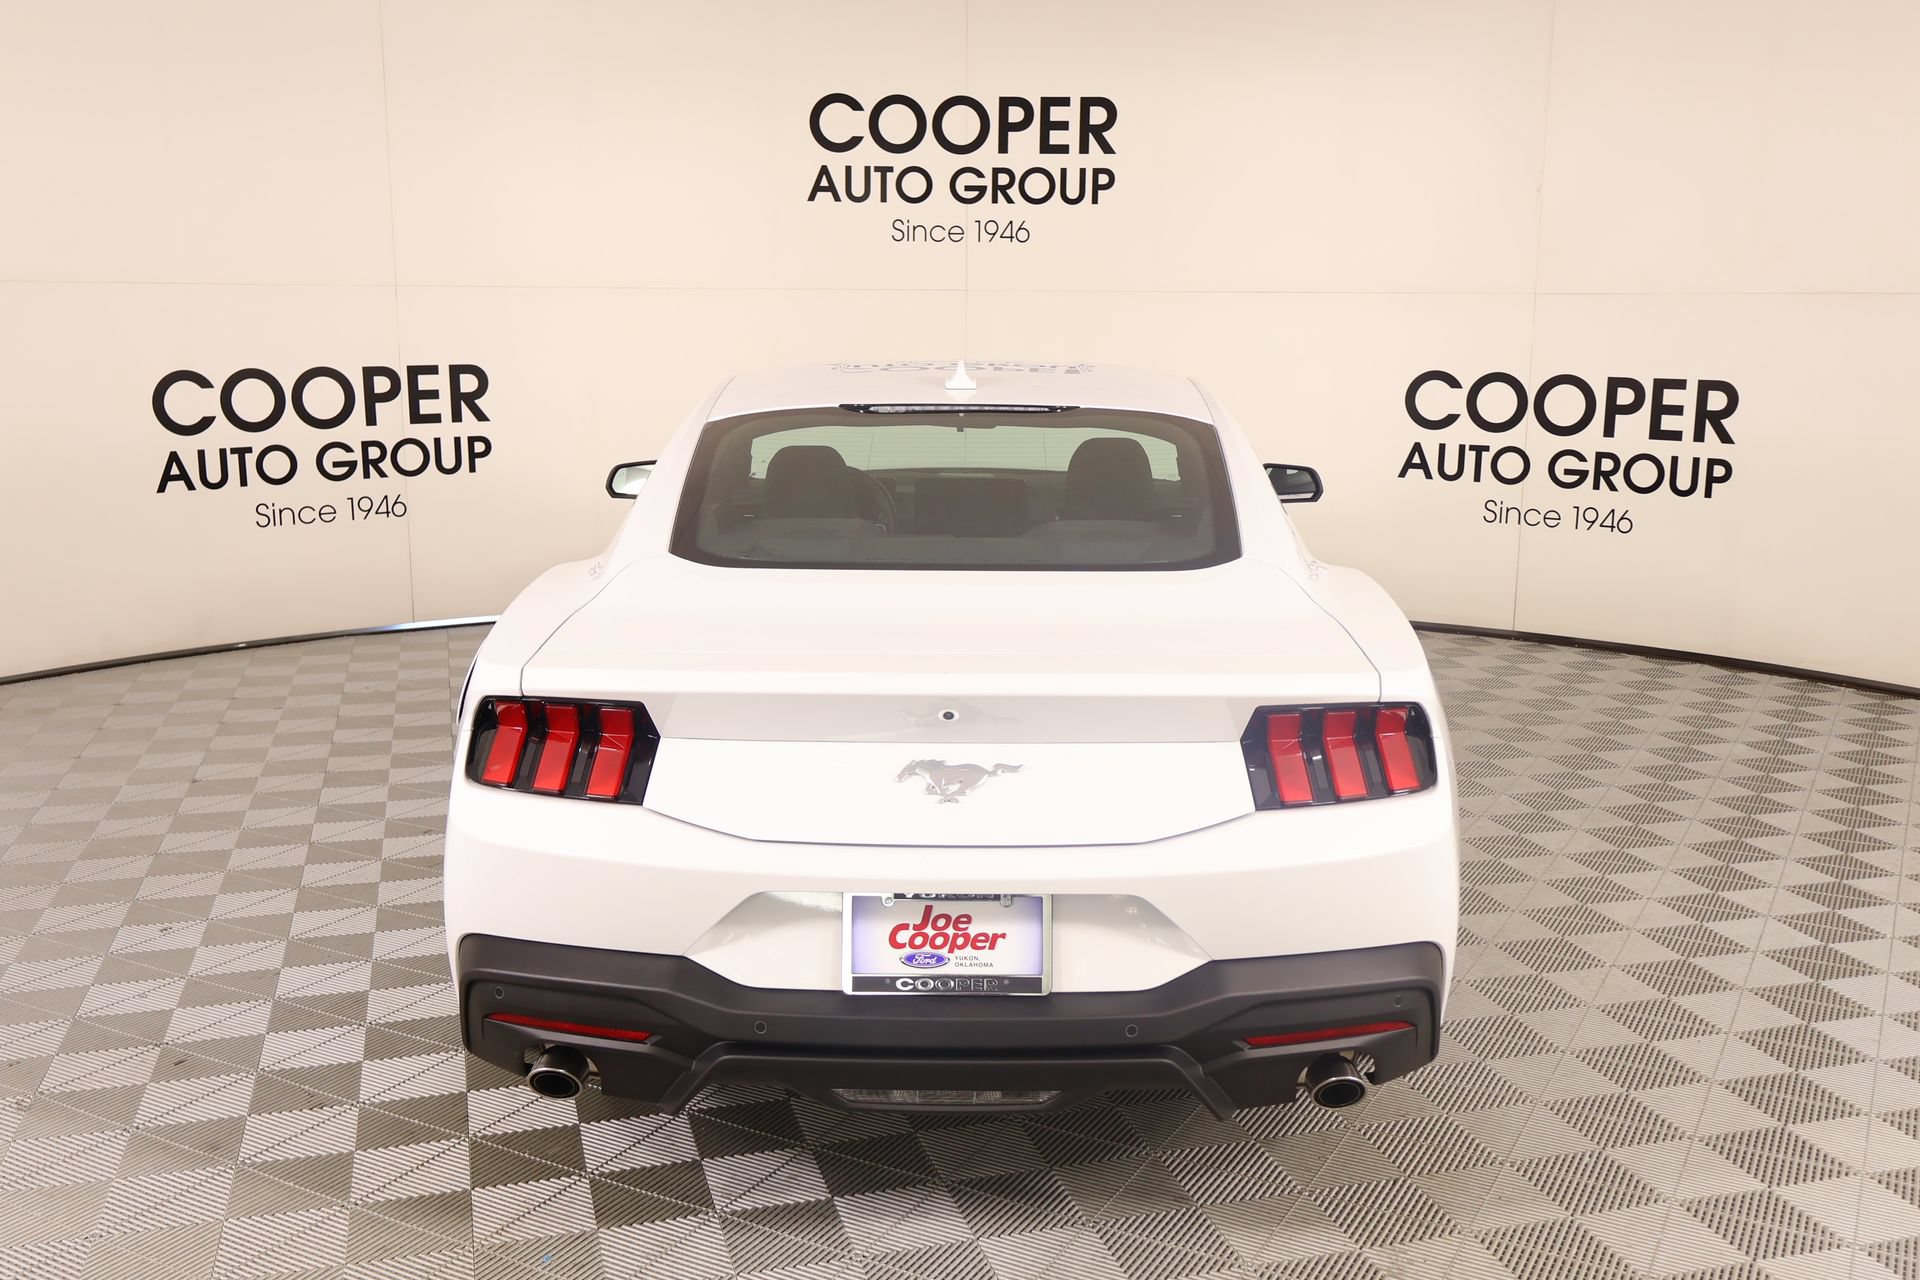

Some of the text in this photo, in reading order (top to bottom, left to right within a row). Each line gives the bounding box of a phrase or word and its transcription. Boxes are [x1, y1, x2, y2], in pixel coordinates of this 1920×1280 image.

[809, 92, 1118, 155] COOPER
[806, 164, 1116, 206] AUTO GROUP
[891, 218, 1031, 243] Since 1946
[151, 363, 491, 437] COOPER
[1404, 369, 1740, 445] COOPER
[155, 435, 493, 494] AUTO GROUP
[1397, 441, 1733, 499] AUTO GROUP
[255, 493, 408, 529] Since 1946
[1482, 499, 1634, 535] Since 1946
[912, 904, 973, 932] Joe
[888, 922, 1007, 954] Cooper
[912, 953, 938, 965] Ford
[895, 977, 999, 992] COOPER
